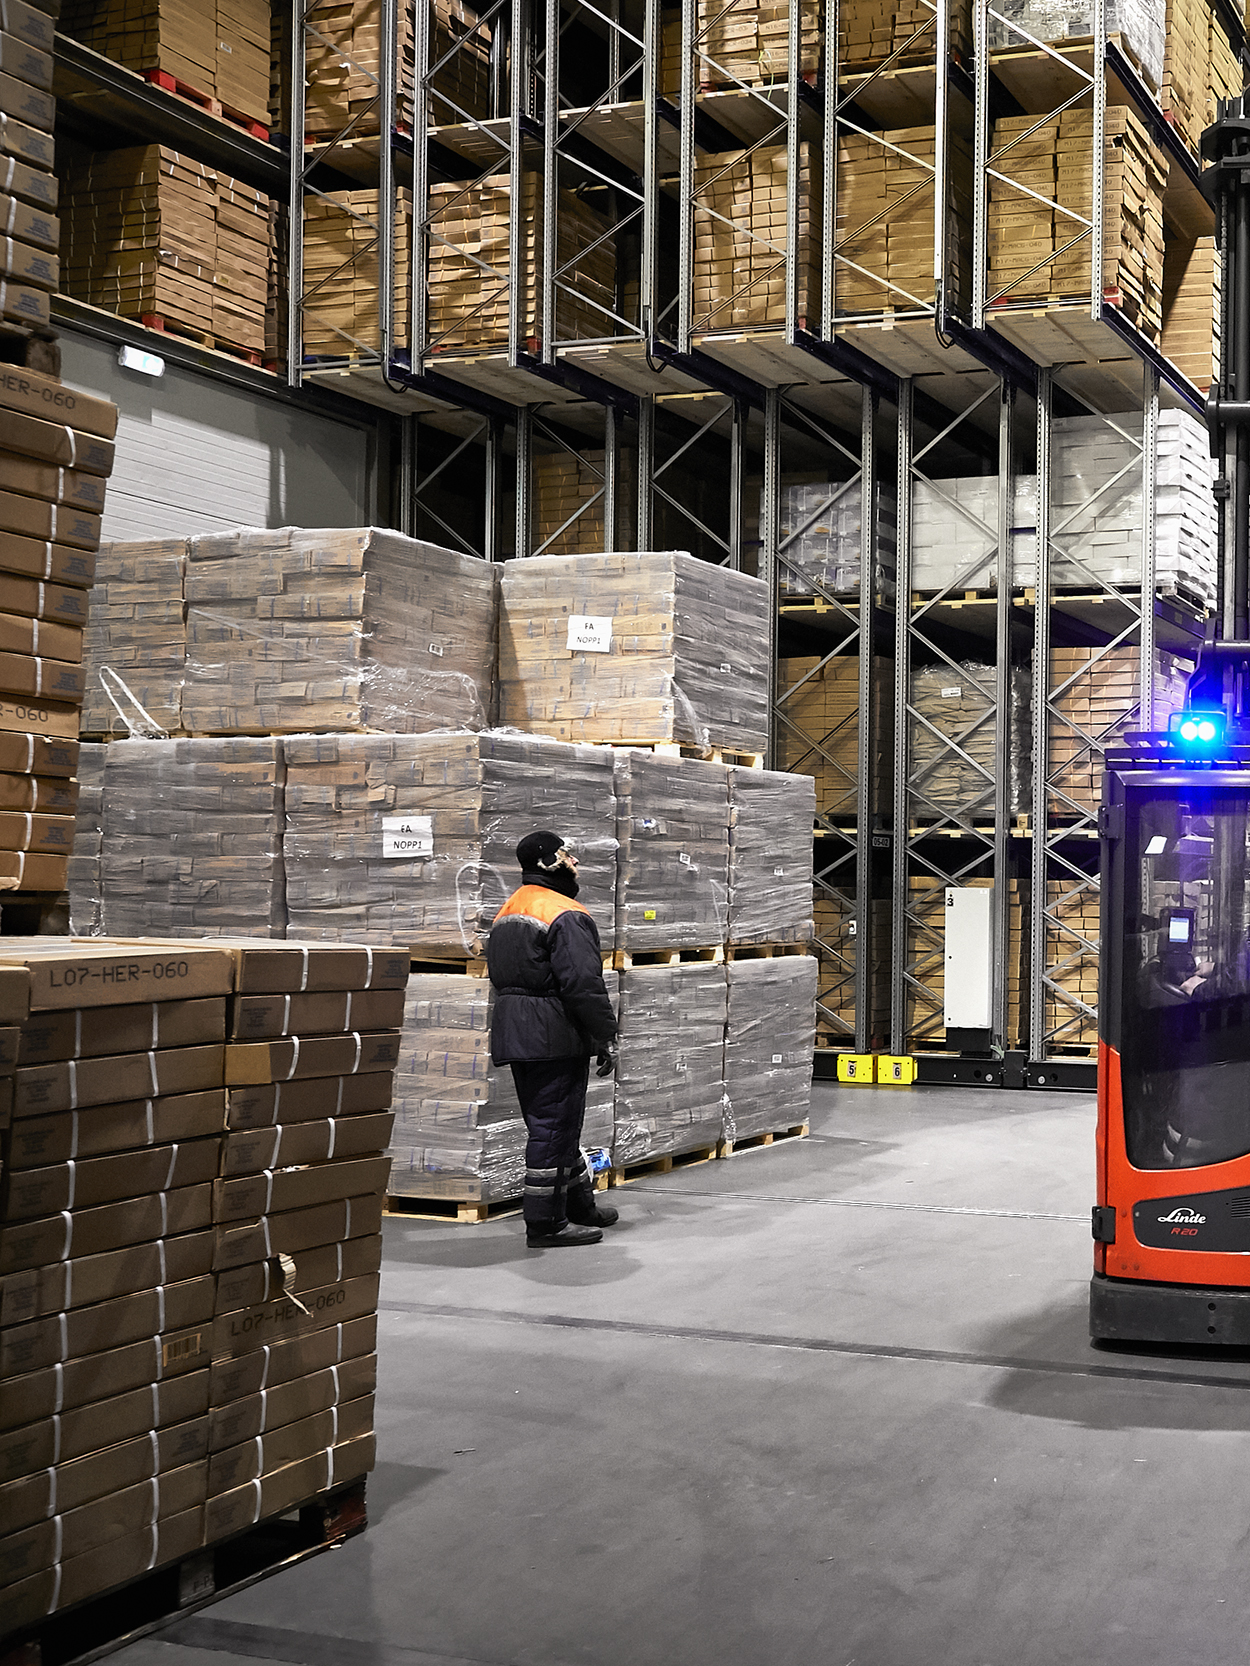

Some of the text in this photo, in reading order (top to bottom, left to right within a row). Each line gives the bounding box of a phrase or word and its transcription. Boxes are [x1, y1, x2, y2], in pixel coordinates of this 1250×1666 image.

[393, 841, 422, 849] NOPP1
[947, 898, 954, 906] 3
[50, 961, 188, 987] L07-HER-060
[848, 1064, 854, 1075] 5
[894, 1066, 900, 1076] 6
[1157, 1207, 1207, 1224] Linde
